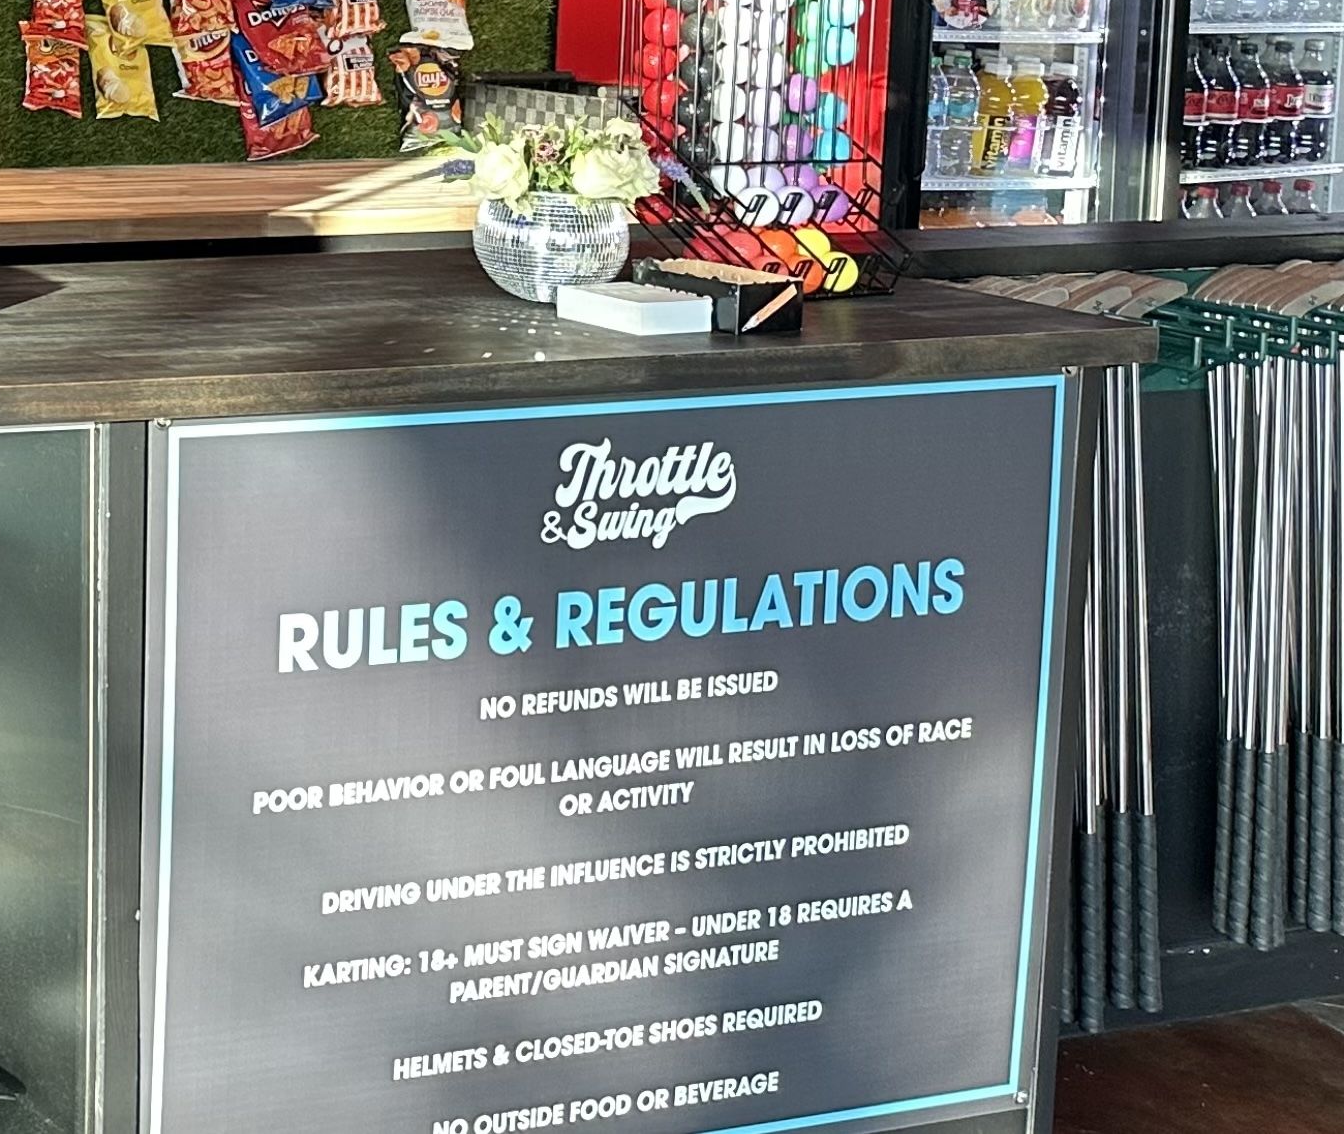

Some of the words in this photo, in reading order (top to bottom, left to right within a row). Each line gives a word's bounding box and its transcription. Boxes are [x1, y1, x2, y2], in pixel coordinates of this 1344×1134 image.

[555, 438, 734, 507] Throttle
[279, 600, 467, 672] RULES
[489, 595, 533, 654] &
[556, 558, 964, 648] REGULATIONS
[480, 695, 516, 719] NO
[521, 685, 617, 715] REFUNDS
[623, 680, 671, 705] WILL
[677, 677, 702, 700] BE
[707, 670, 778, 697] ISSUED
[253, 786, 322, 814] POOR
[329, 773, 444, 806] BEHAVIOR
[449, 769, 484, 793] OR
[489, 762, 545, 789] FOUL
[551, 749, 670, 782] LANGUAGE
[675, 744, 723, 768] WILL
[728, 735, 799, 763] RESULT
[803, 732, 825, 755] IN
[831, 727, 881, 752] LOSS
[885, 723, 914, 746] OF
[918, 717, 972, 743] RACE
[559, 793, 592, 816] OR
[596, 781, 694, 812] ACTIVITY
[322, 882, 420, 914] DRIVING
[427, 873, 501, 901] UNDER
[505, 866, 545, 891] THE
[551, 852, 665, 886] INFLUENCE
[670, 850, 690, 872] IS
[694, 838, 786, 869] STRICTLY
[791, 824, 909, 857] PROHIBITED
[303, 954, 411, 988] KARTING:
[419, 949, 458, 972] 18+
[464, 938, 524, 967] MUST
[527, 931, 582, 958] SIGN
[587, 920, 670, 950] WAIVER
[692, 909, 761, 937] UNDER
[767, 904, 791, 927] 18
[797, 891, 893, 923] REQUIRES
[896, 889, 912, 910] A
[449, 955, 658, 1003] PARENT/GUARDIAN
[663, 939, 779, 974] SIGNATURE
[393, 1047, 487, 1080] HELMETS
[493, 1044, 509, 1065] &
[515, 1024, 644, 1062] CLOSED-TOE
[649, 1014, 717, 1044] SHOES
[722, 1000, 822, 1033] REQUIRED
[473, 1103, 564, 1134] OUTSIDE
[569, 1094, 631, 1122] FOOD
[637, 1088, 669, 1111] OR
[674, 1071, 779, 1106] BEVERAGE
